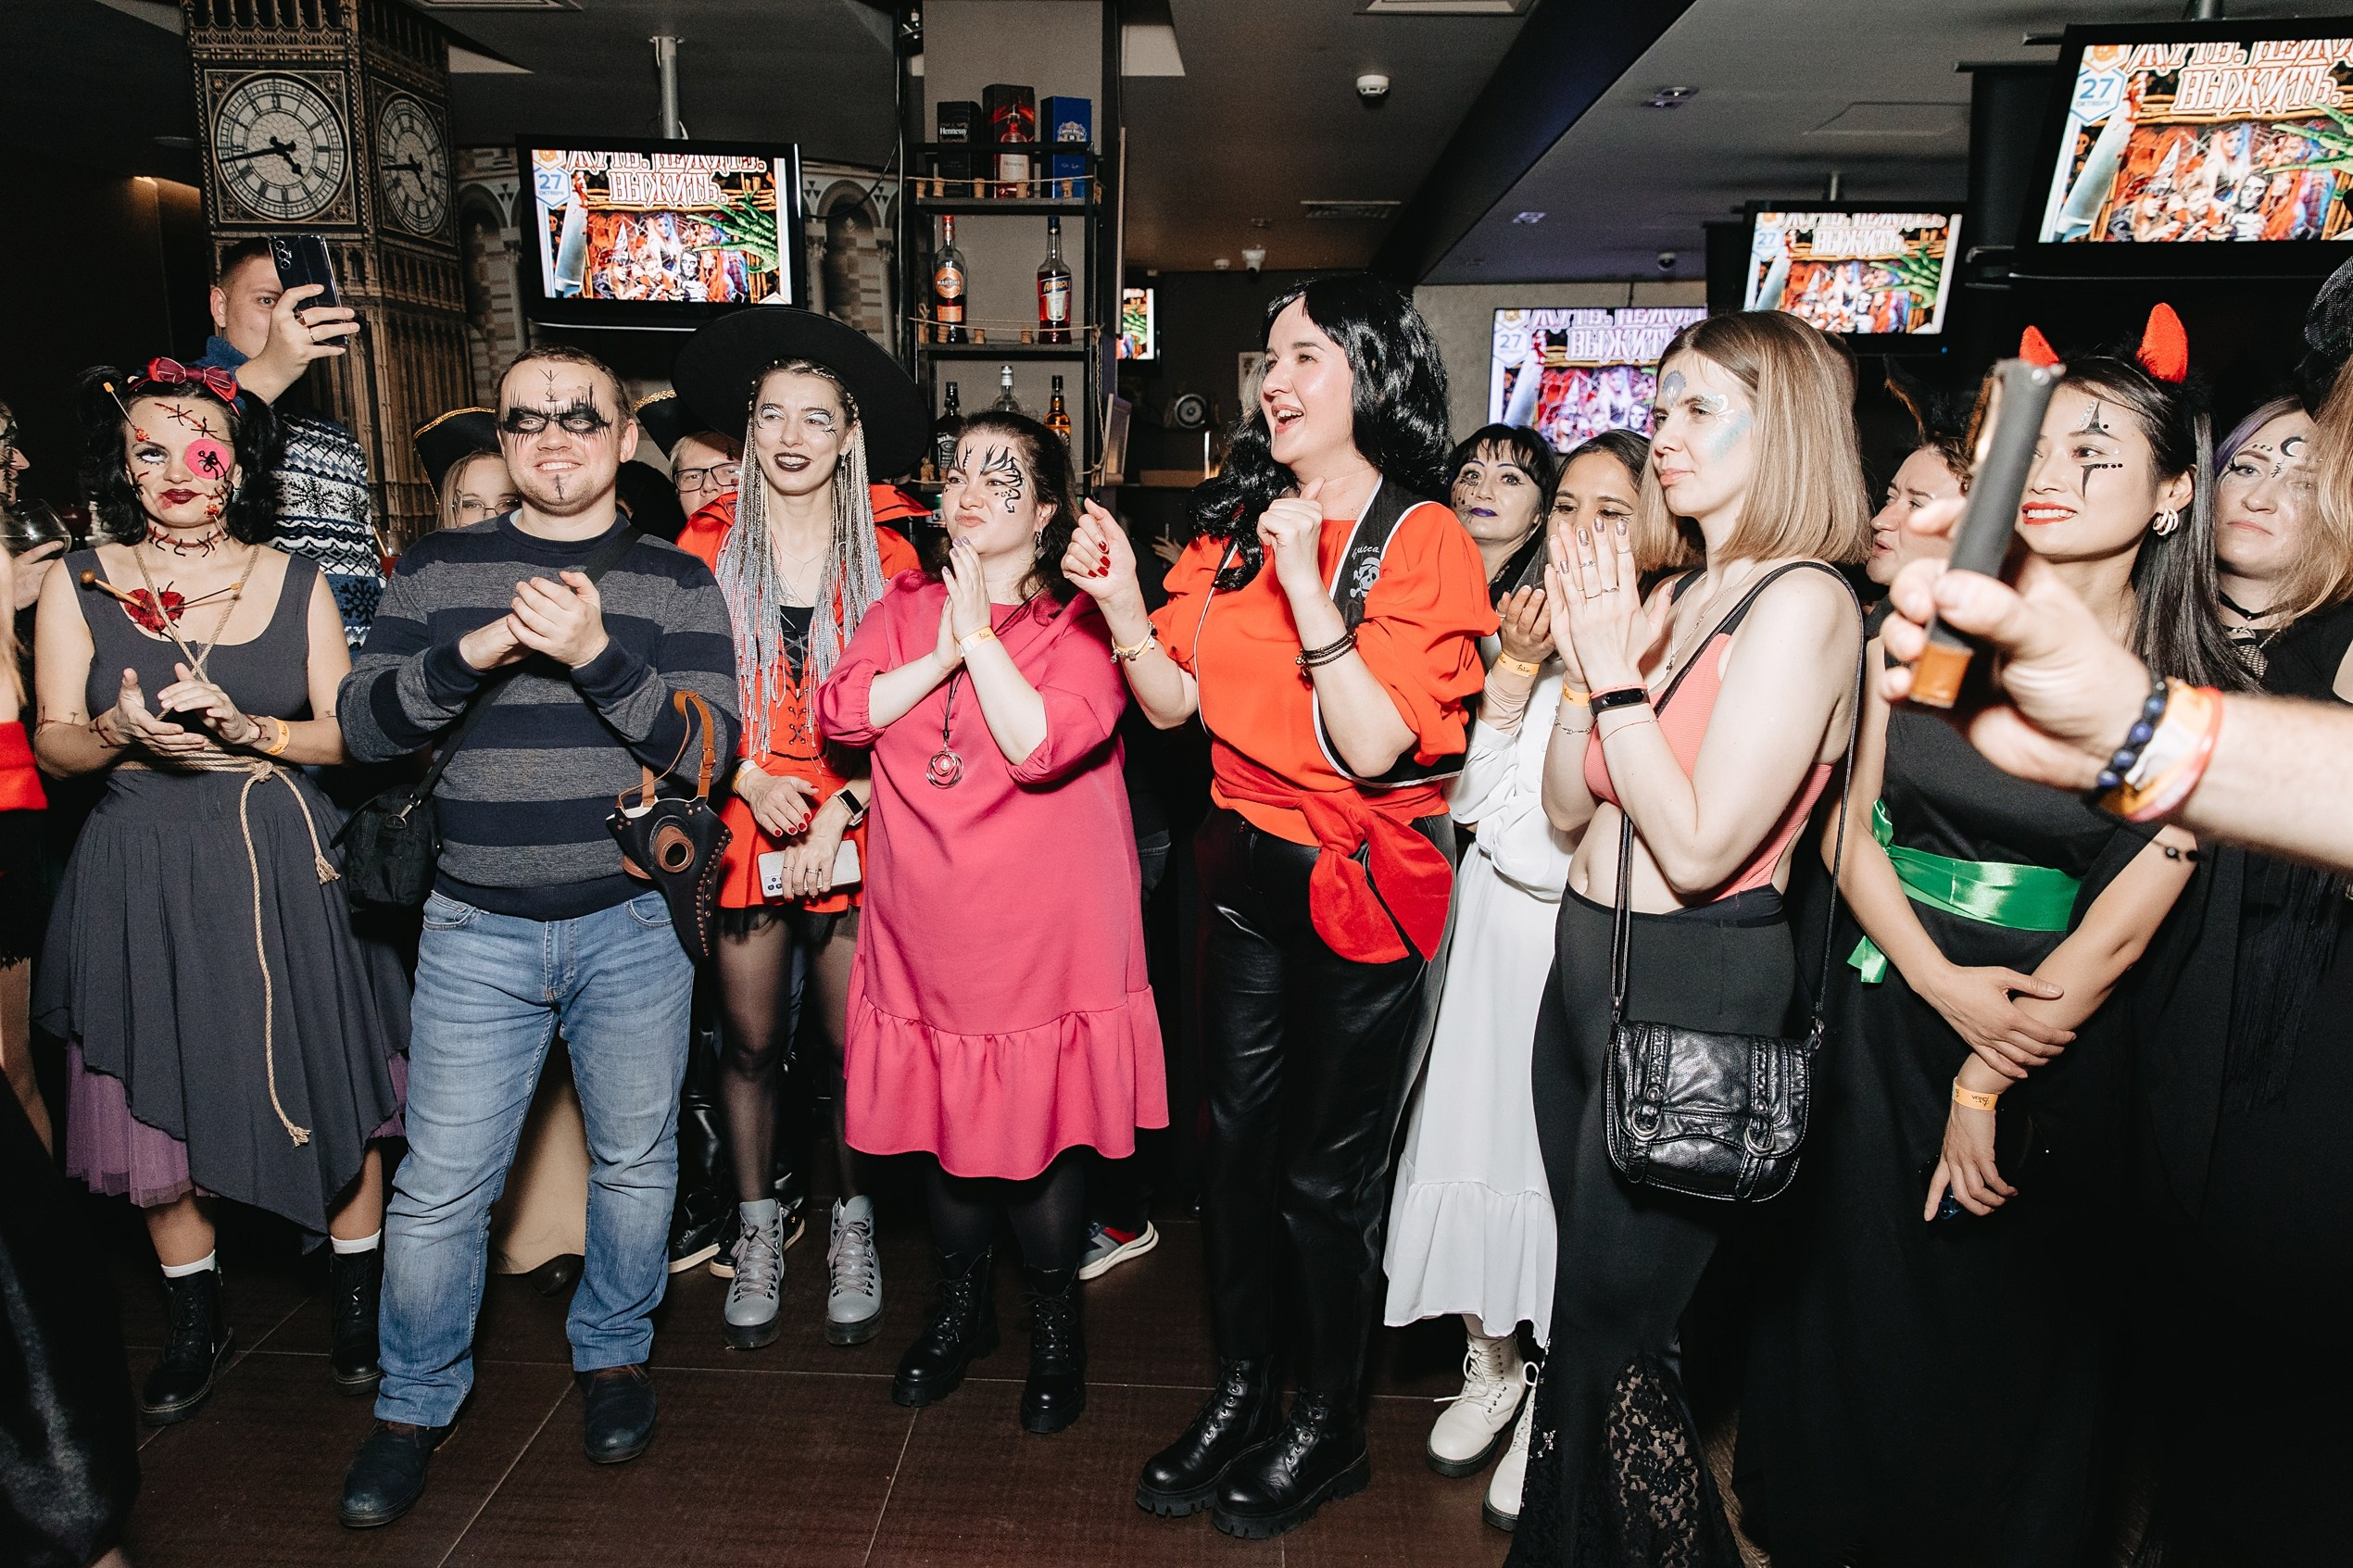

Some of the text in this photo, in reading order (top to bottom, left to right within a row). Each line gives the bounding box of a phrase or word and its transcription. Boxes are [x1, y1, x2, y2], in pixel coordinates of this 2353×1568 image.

[2080, 78, 2115, 99] 27
[939, 127, 967, 136] Hennessy
[538, 173, 562, 190] 27
[1758, 232, 1777, 245] 27
[1499, 334, 1522, 349] 27
